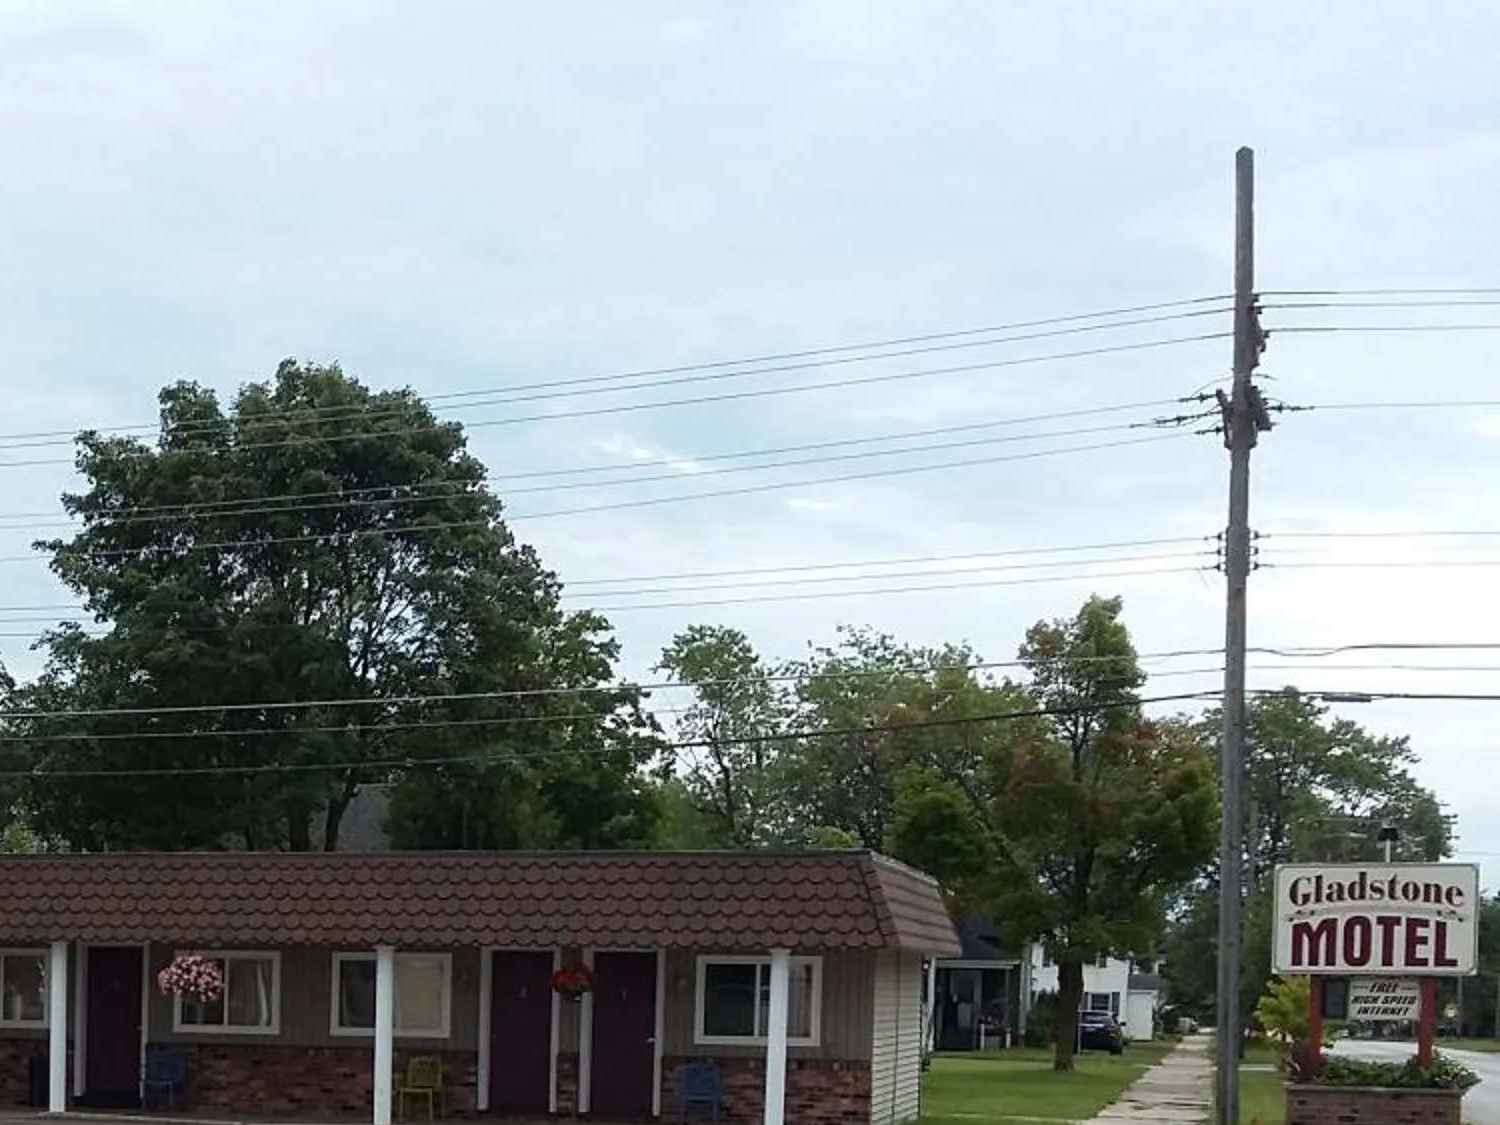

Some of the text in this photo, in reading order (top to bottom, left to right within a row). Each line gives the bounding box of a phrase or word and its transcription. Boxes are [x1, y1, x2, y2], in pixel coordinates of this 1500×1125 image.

[1289, 871, 1464, 907] Gladstone
[1291, 916, 1458, 967] MOTEL
[1369, 982, 1398, 993] FREE
[1351, 995, 1416, 1004] HIGH SPEED
[1357, 1006, 1409, 1016] INTERNET
